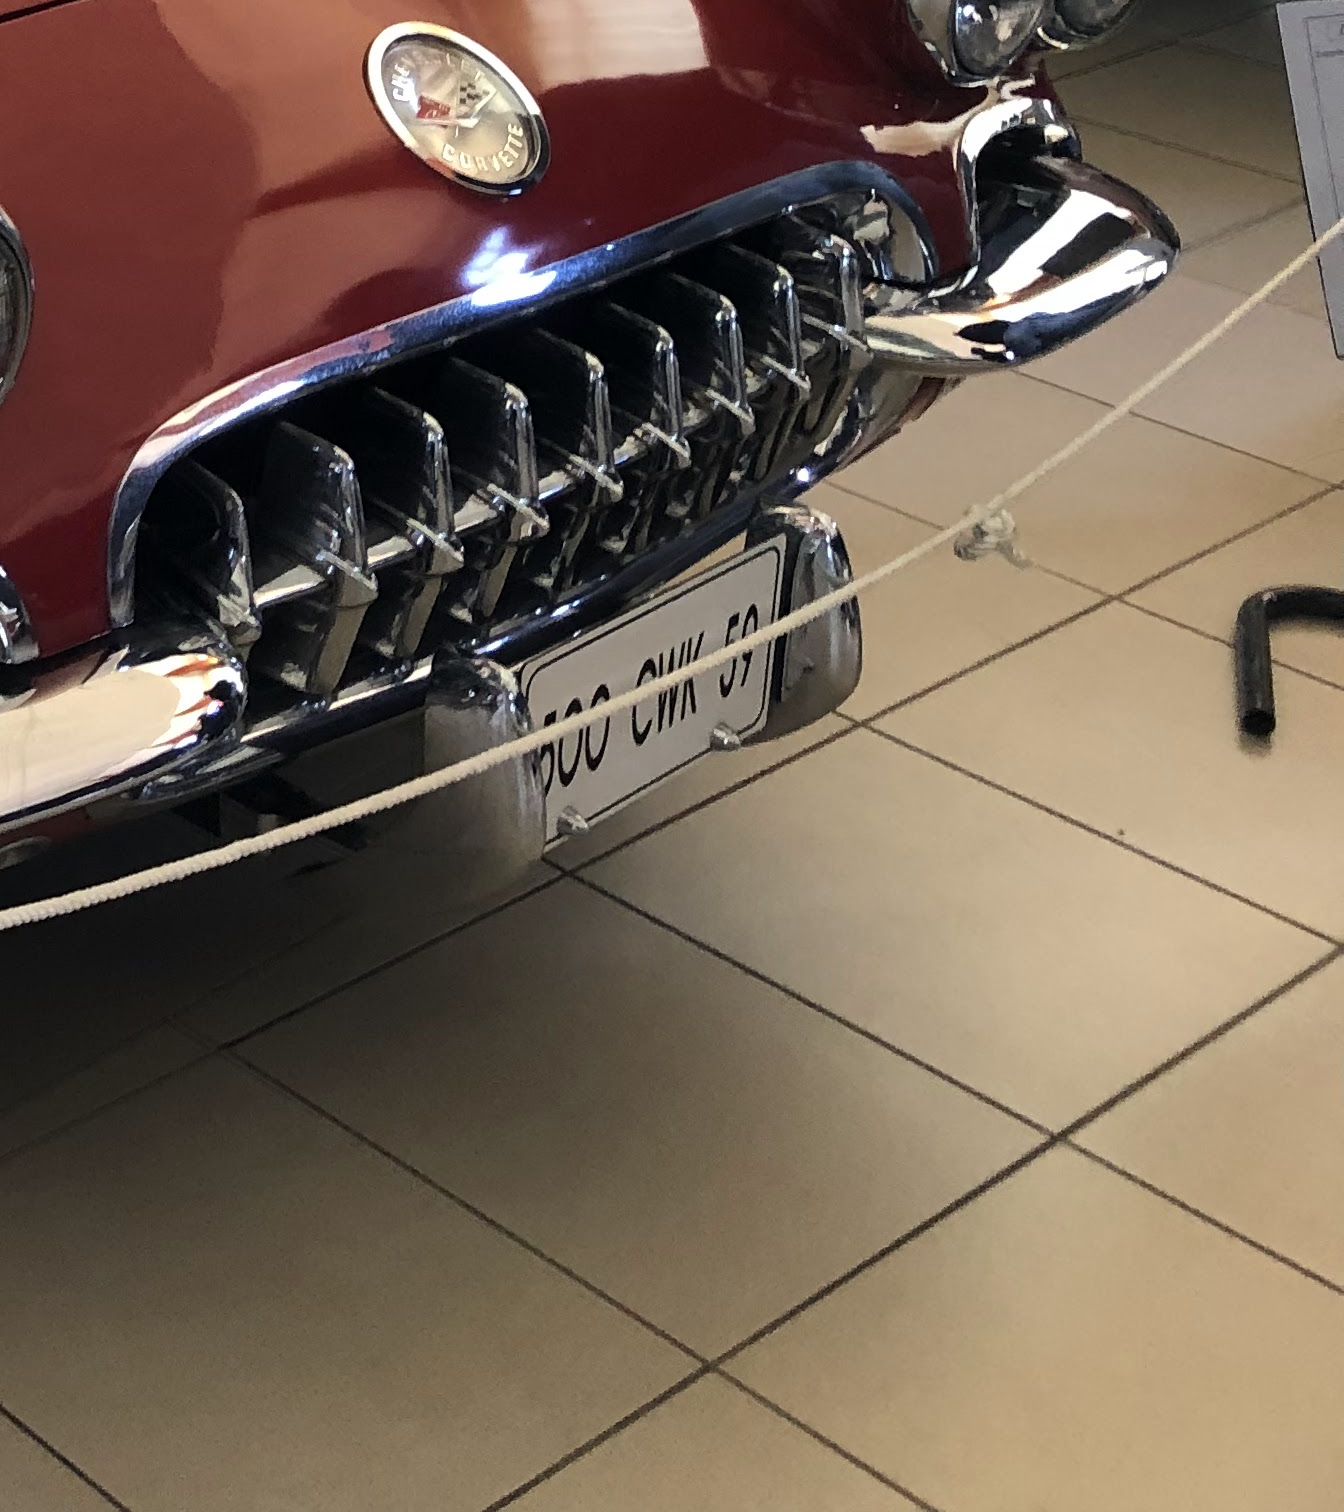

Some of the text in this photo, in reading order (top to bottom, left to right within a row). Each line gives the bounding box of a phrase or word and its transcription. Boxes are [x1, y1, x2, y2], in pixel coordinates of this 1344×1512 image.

[442, 123, 524, 172] CORVETTE
[631, 630, 705, 747] CWK
[719, 603, 759, 699] 59
